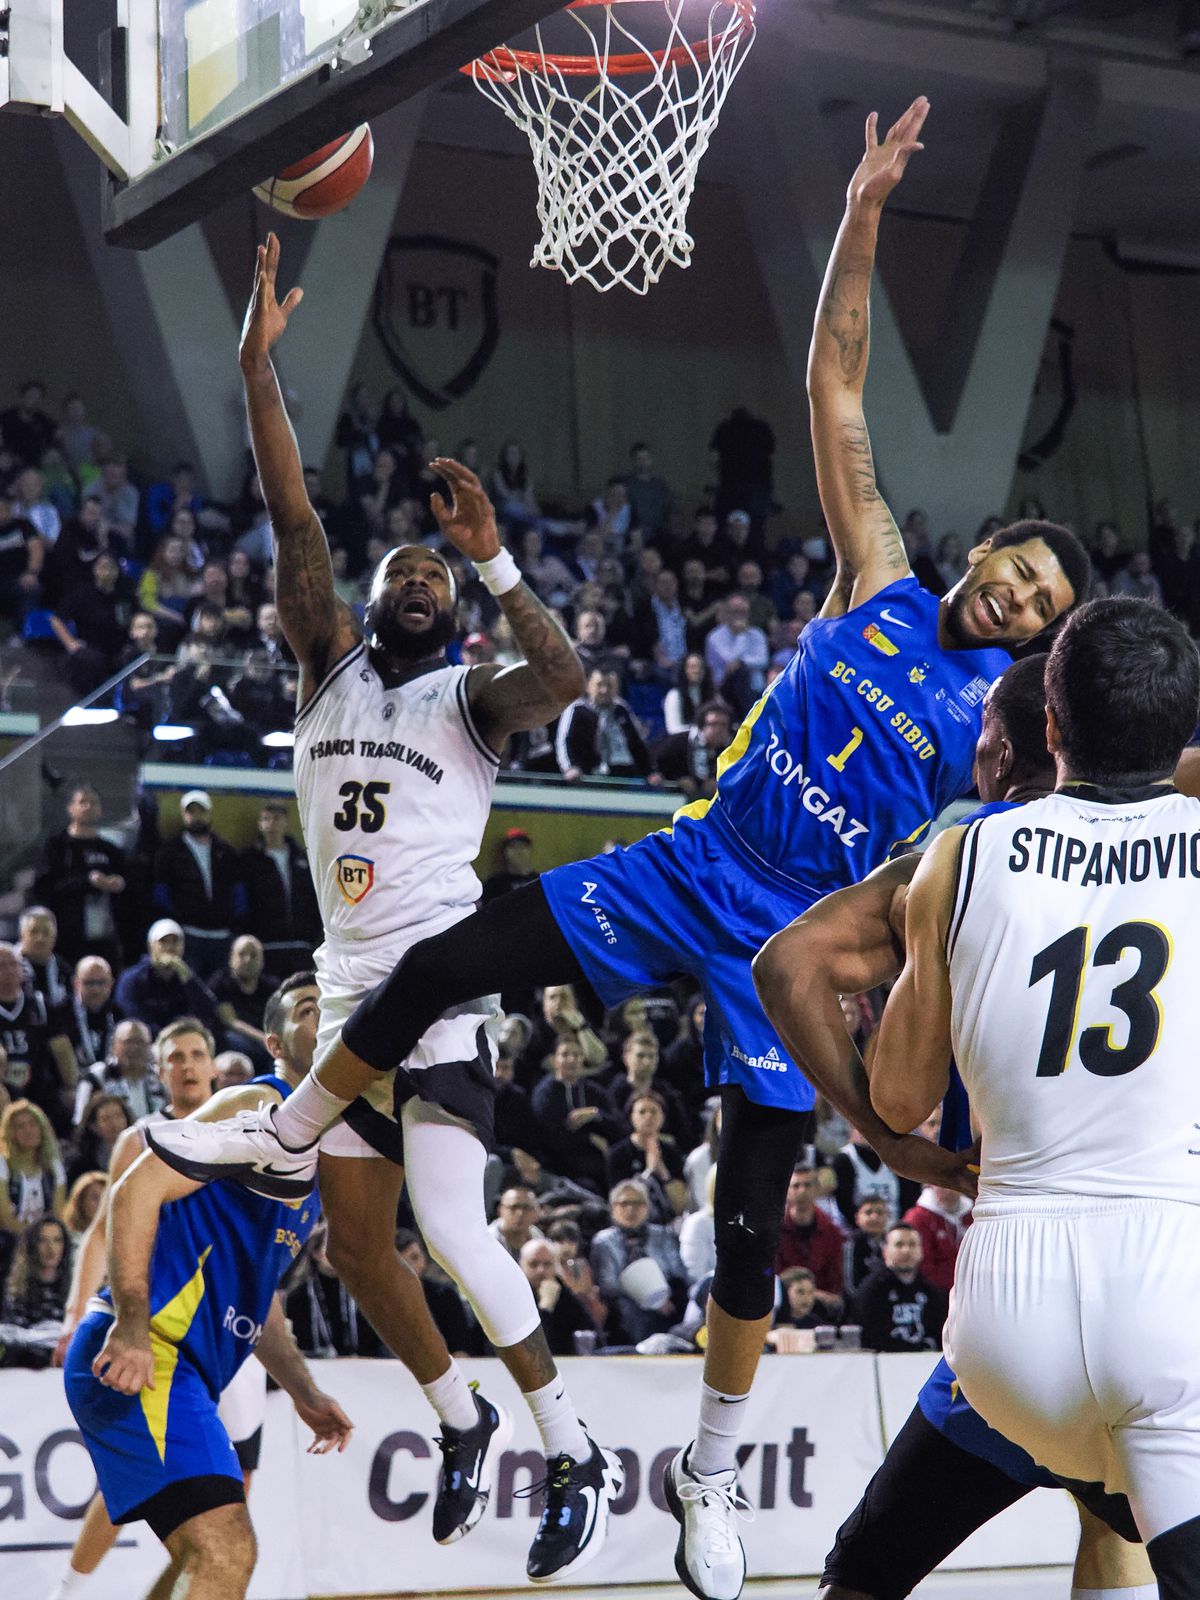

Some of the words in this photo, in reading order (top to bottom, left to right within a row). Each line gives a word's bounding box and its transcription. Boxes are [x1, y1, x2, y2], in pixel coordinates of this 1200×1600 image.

[407, 285, 468, 330] BT
[828, 660, 857, 685] BC
[856, 678, 895, 713] CSU
[889, 711, 937, 761] SIBIU
[826, 726, 864, 773] 1
[333, 780, 391, 834] 35
[343, 866, 367, 885] BT
[591, 906, 618, 946] AZETS
[1028, 918, 1175, 1078] 13
